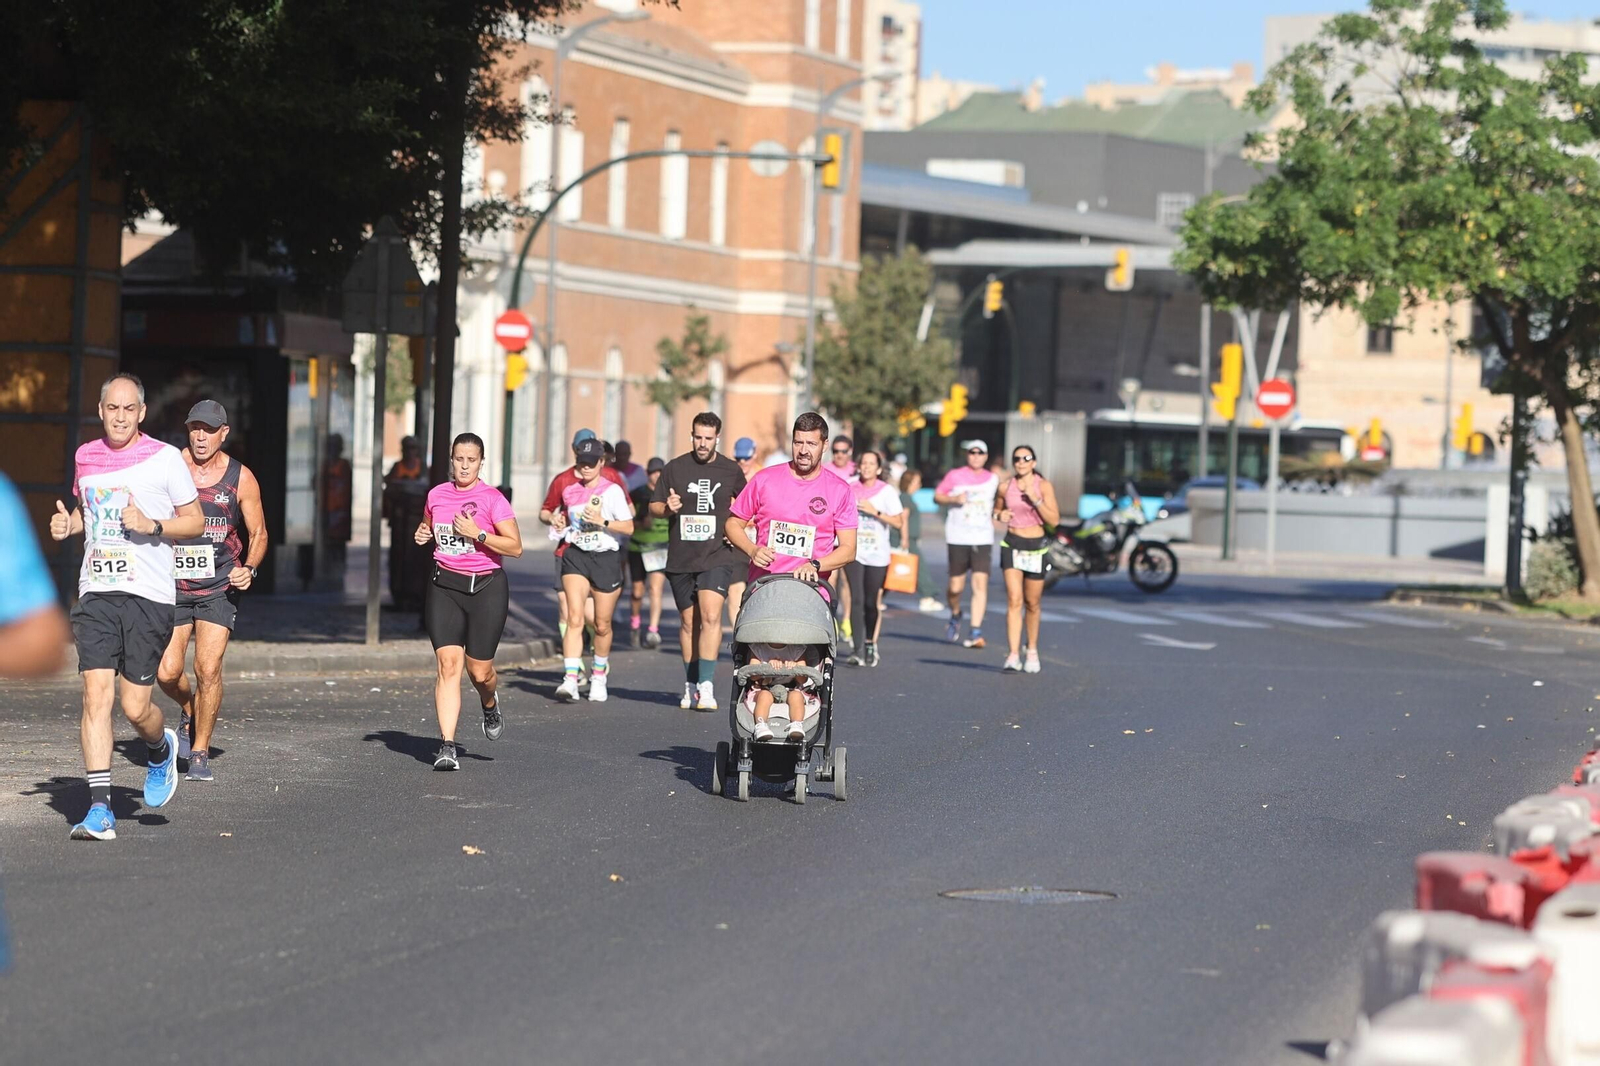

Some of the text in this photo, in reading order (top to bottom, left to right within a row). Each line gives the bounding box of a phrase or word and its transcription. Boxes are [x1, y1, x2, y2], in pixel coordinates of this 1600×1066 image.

[686, 524, 710, 533] 380
[440, 534, 465, 548] 521
[575, 533, 599, 545] 264
[775, 532, 806, 548] 301
[92, 560, 128, 573] 512
[175, 556, 208, 569] 598
